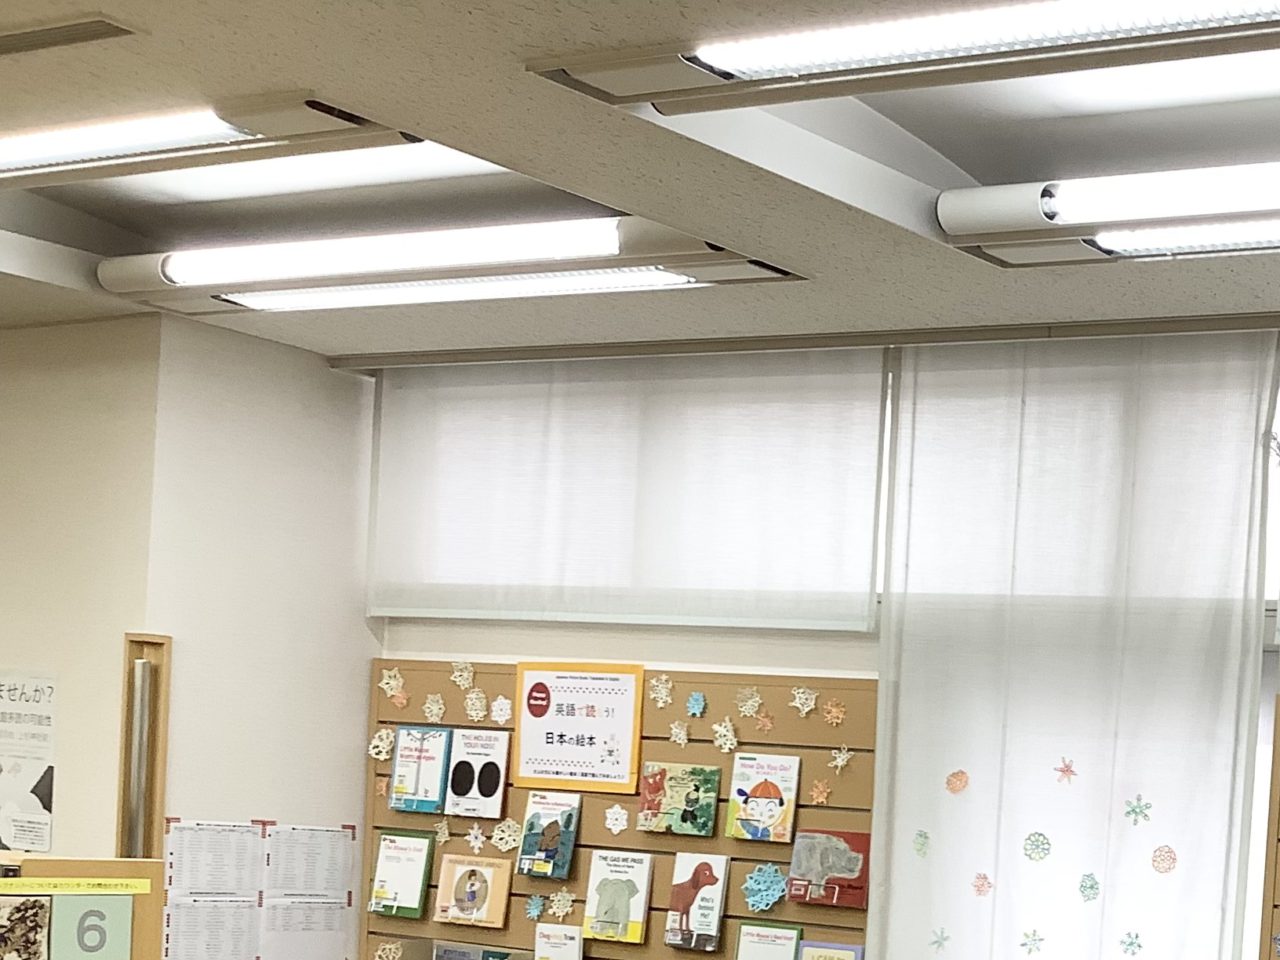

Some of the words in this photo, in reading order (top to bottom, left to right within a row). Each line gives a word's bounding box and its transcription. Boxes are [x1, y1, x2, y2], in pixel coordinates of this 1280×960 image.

[545, 732, 597, 747] 日本の絵本
[77, 909, 107, 954] 6
